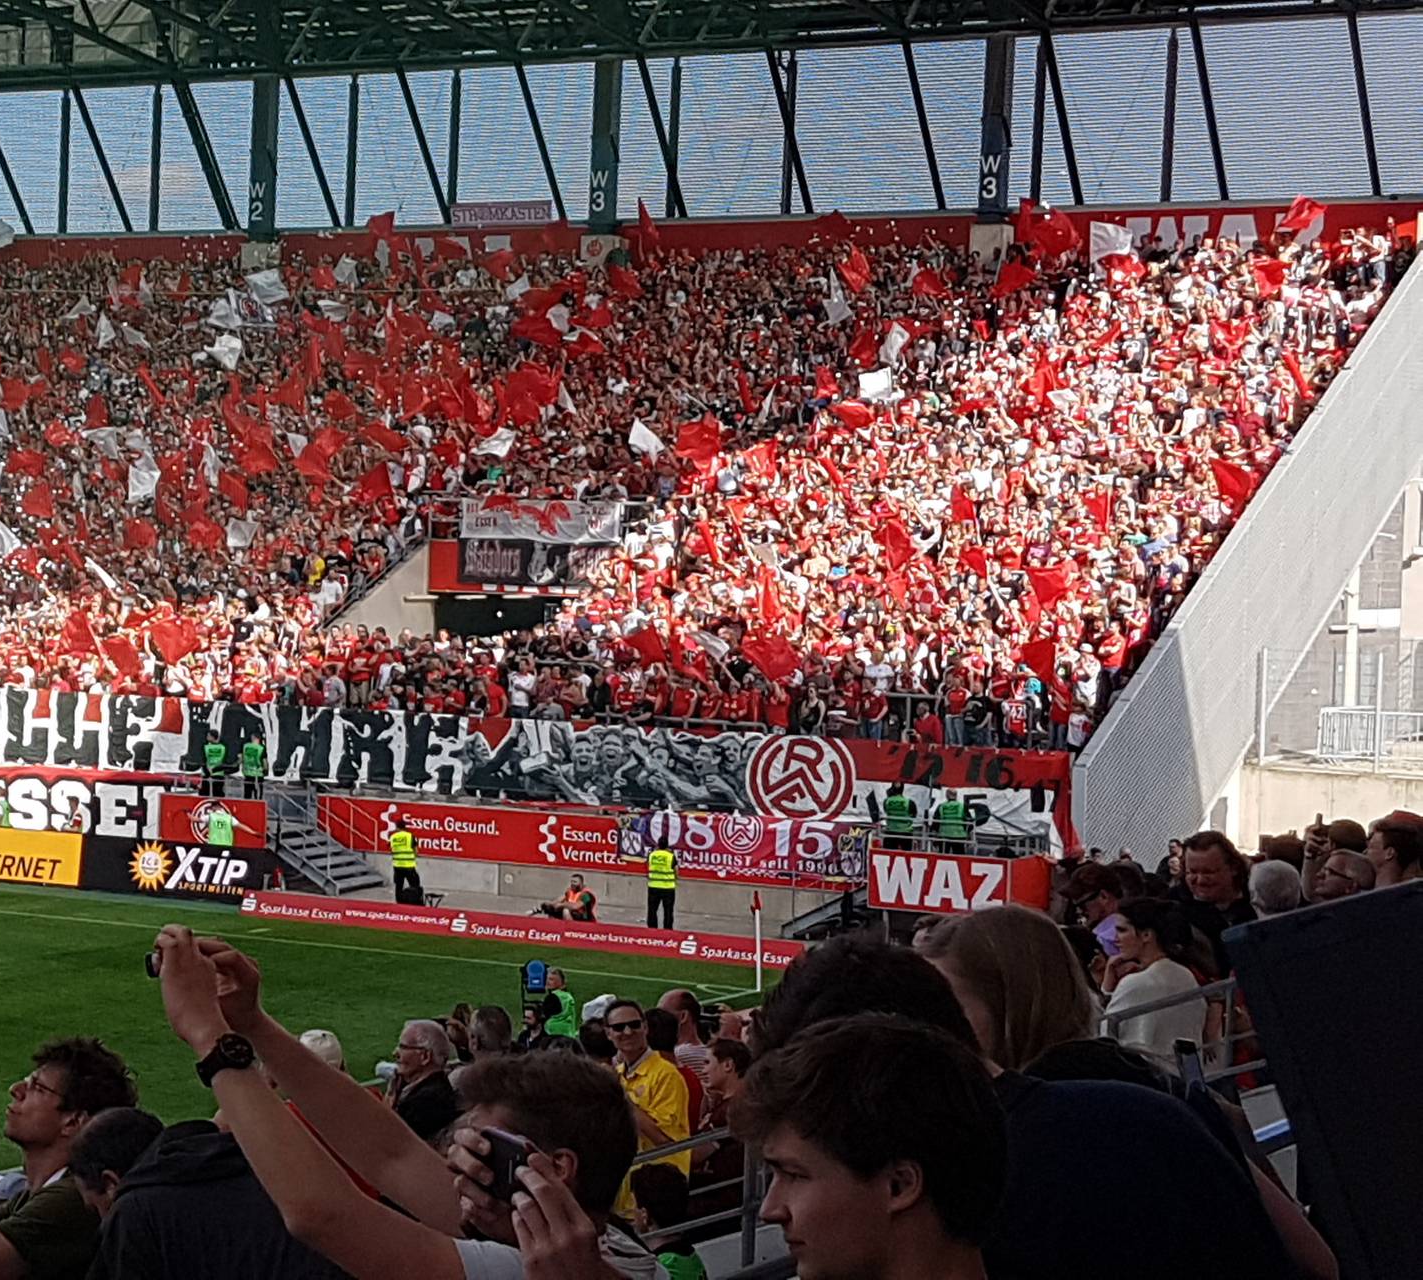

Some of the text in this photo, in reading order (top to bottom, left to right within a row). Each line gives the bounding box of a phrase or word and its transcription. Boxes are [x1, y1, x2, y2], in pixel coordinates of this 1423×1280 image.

[981, 154, 1001, 174] W
[248, 181, 267, 198] W
[590, 169, 609, 189] W
[982, 177, 998, 199] 3
[250, 202, 264, 222] 2
[591, 191, 605, 213] 3
[415, 836, 465, 853] rnetzt.
[768, 818, 837, 861] 15
[177, 880, 245, 896] SPORTWETTEN
[872, 853, 1005, 911] WAZ
[257, 901, 310, 919] Sparkasse
[310, 906, 342, 921] Essen
[344, 907, 450, 927] www.sparkasse-essen.de
[468, 921, 527, 941] Sparkasse
[527, 928, 562, 943] Essen
[563, 930, 679, 949] www.sparkasse-essen.de
